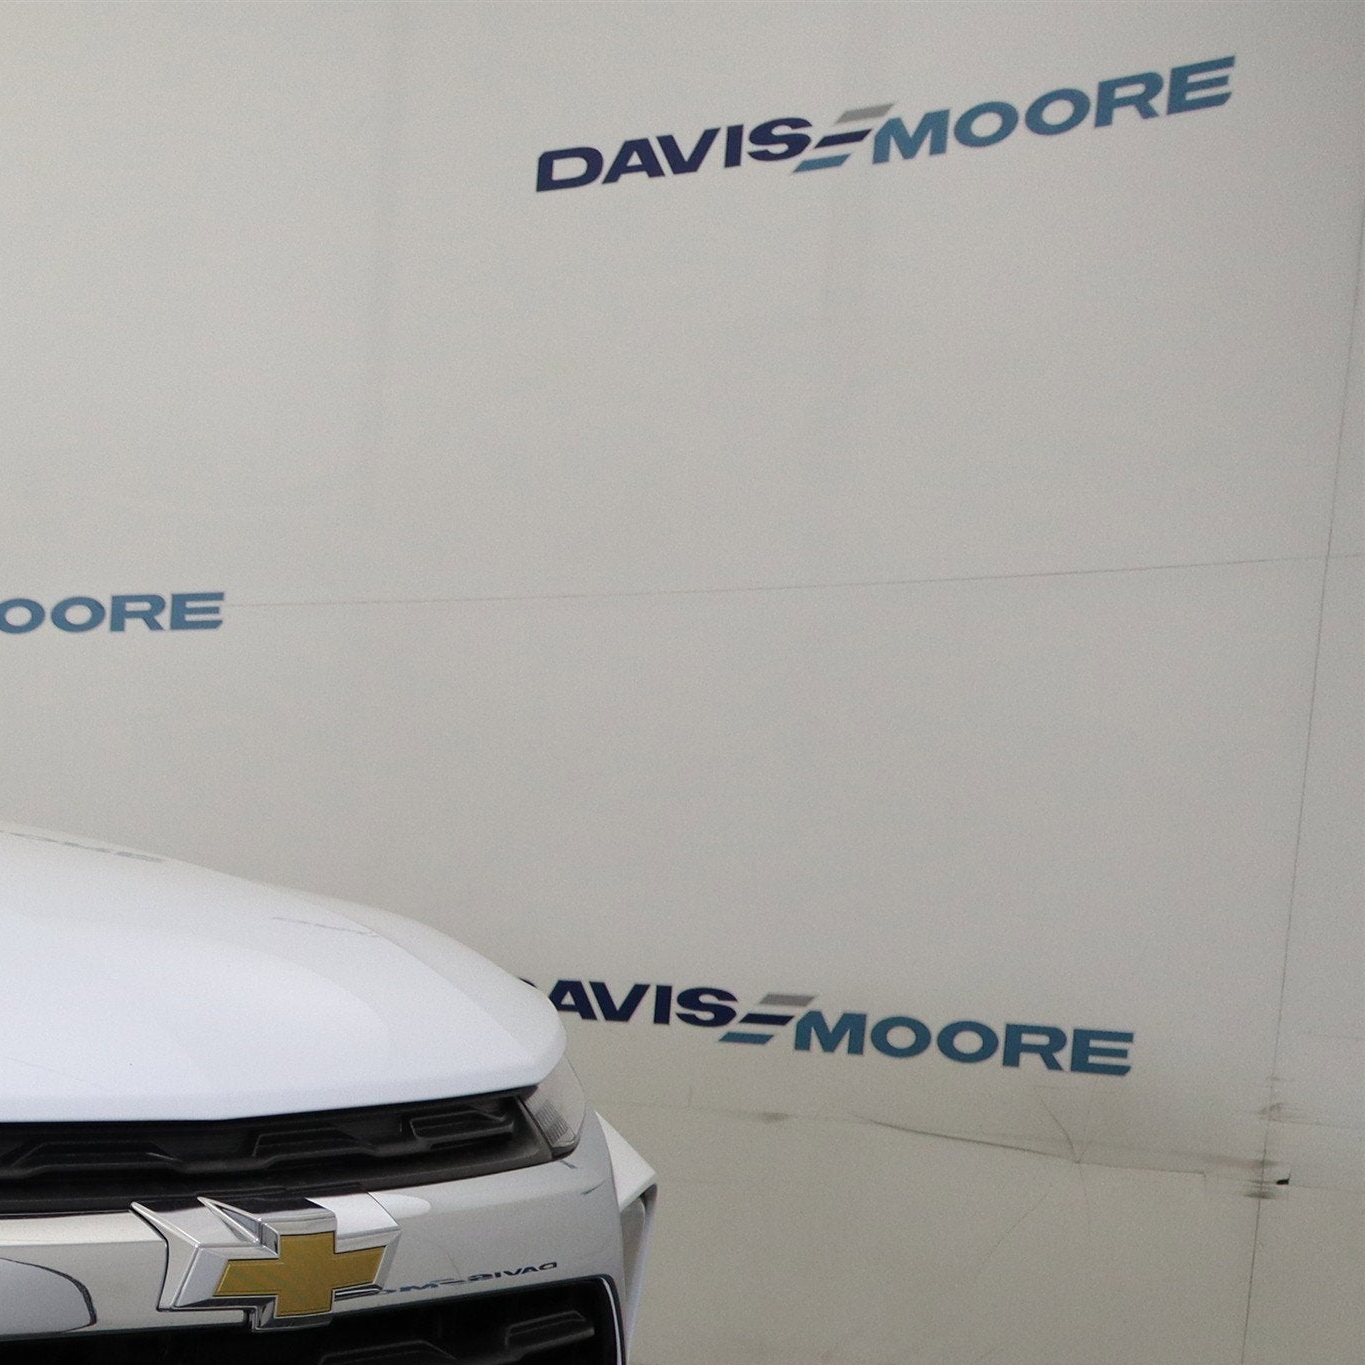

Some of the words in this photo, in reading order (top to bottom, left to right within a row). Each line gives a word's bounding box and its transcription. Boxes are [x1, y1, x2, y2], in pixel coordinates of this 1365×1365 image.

[536, 116, 812, 192] DAVIS
[872, 55, 1236, 165] MOORE
[518, 977, 739, 1028] AVIS
[794, 1010, 1134, 1077] MOORE
